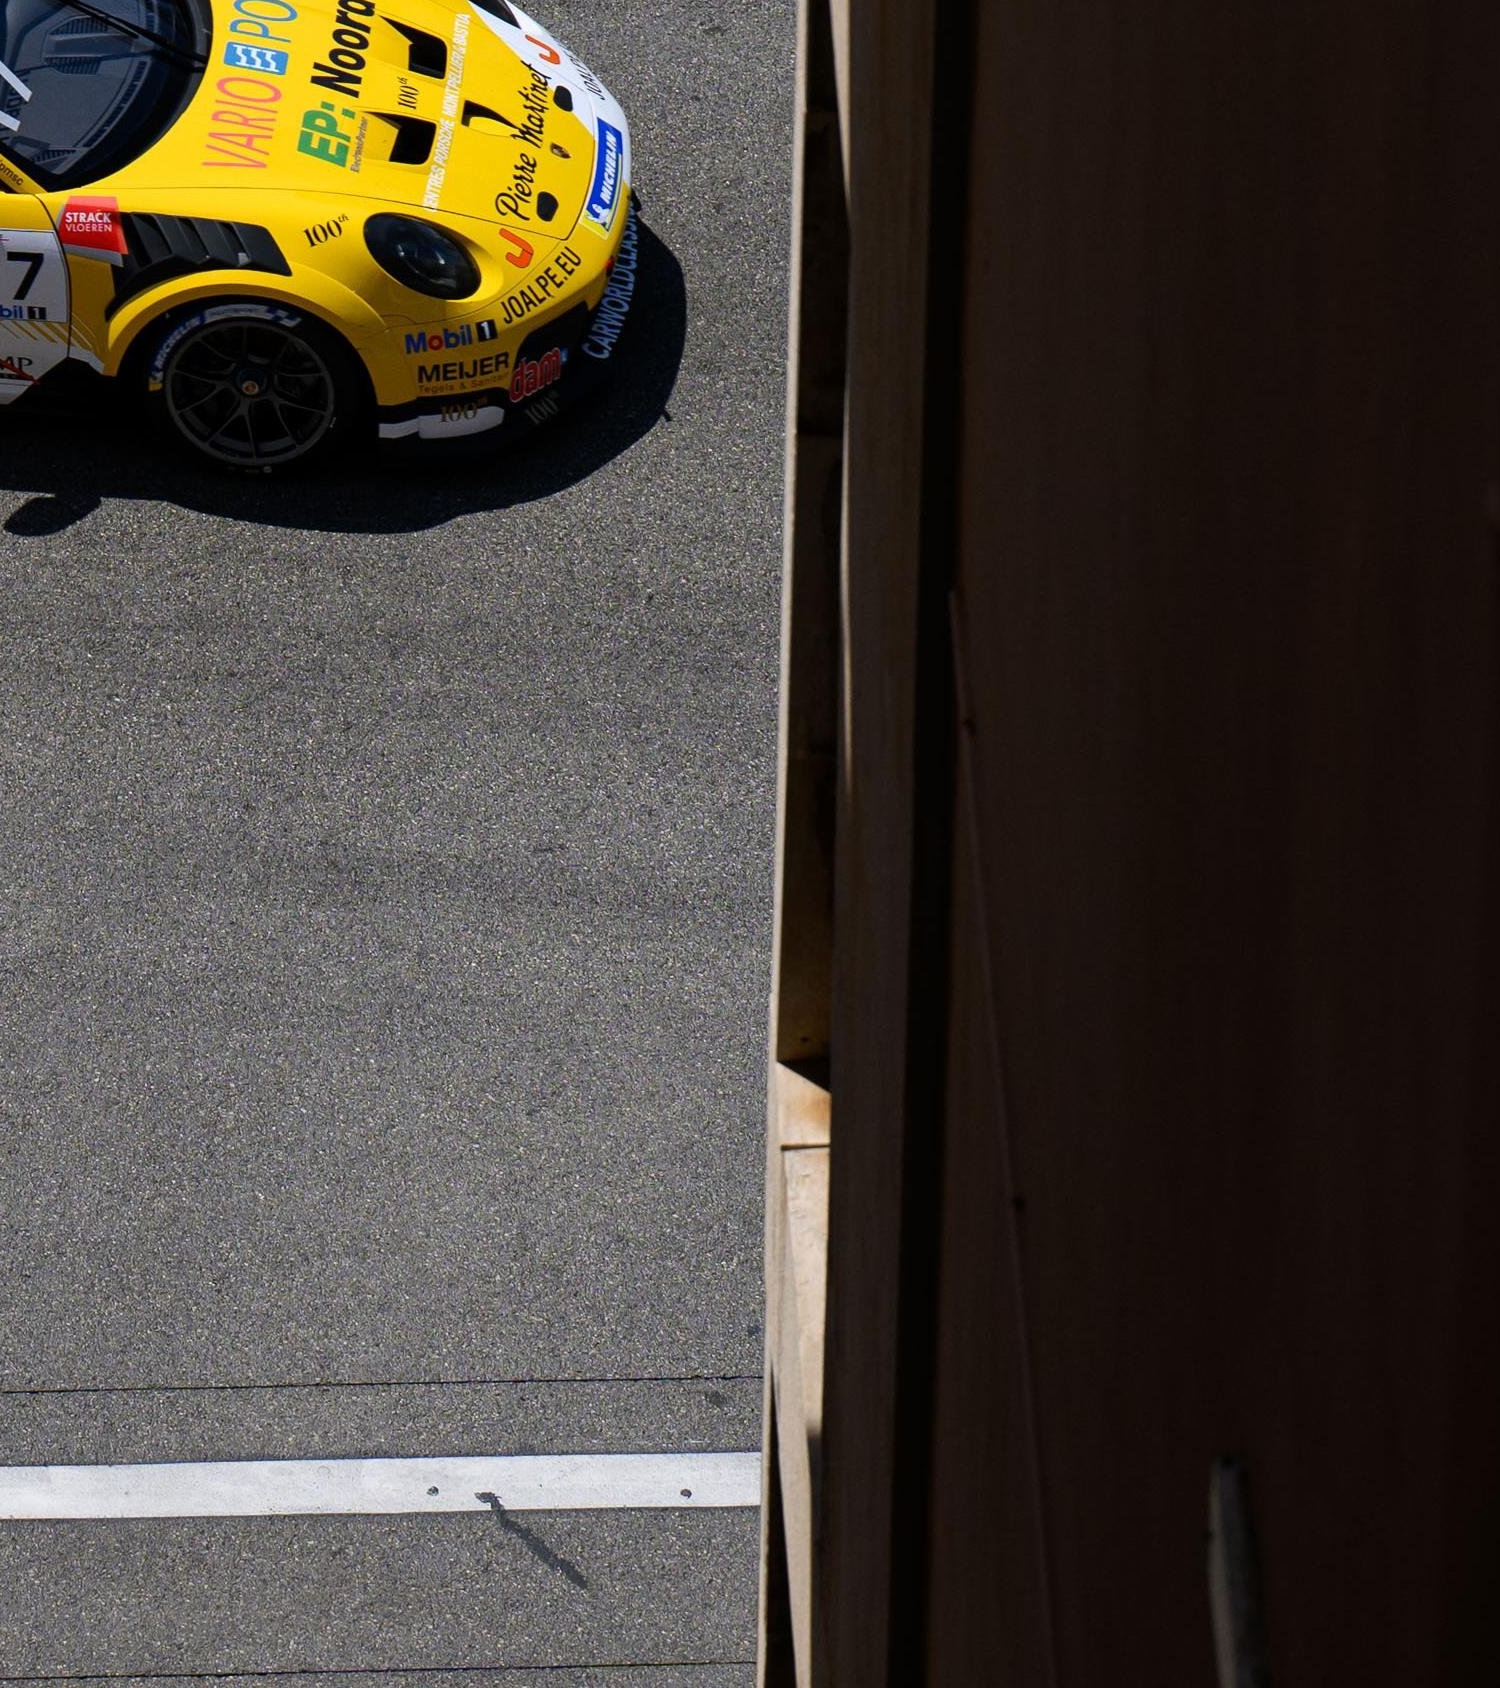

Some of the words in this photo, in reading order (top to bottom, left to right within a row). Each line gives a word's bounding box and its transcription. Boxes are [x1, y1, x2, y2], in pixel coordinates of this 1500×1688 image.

[200, 77, 282, 169] VARIO
[511, 59, 553, 148] Martinet
[430, 118, 455, 166] PORSCHE
[494, 153, 538, 221] Pierre
[600, 132, 618, 205] MICHELIN
[65, 211, 112, 223] STRACK
[65, 222, 113, 233] VLOEREN
[303, 213, 350, 247] 100th
[500, 246, 582, 324] JOALPE.EU
[404, 325, 473, 354] Mobil
[418, 352, 510, 383] MEIJER
